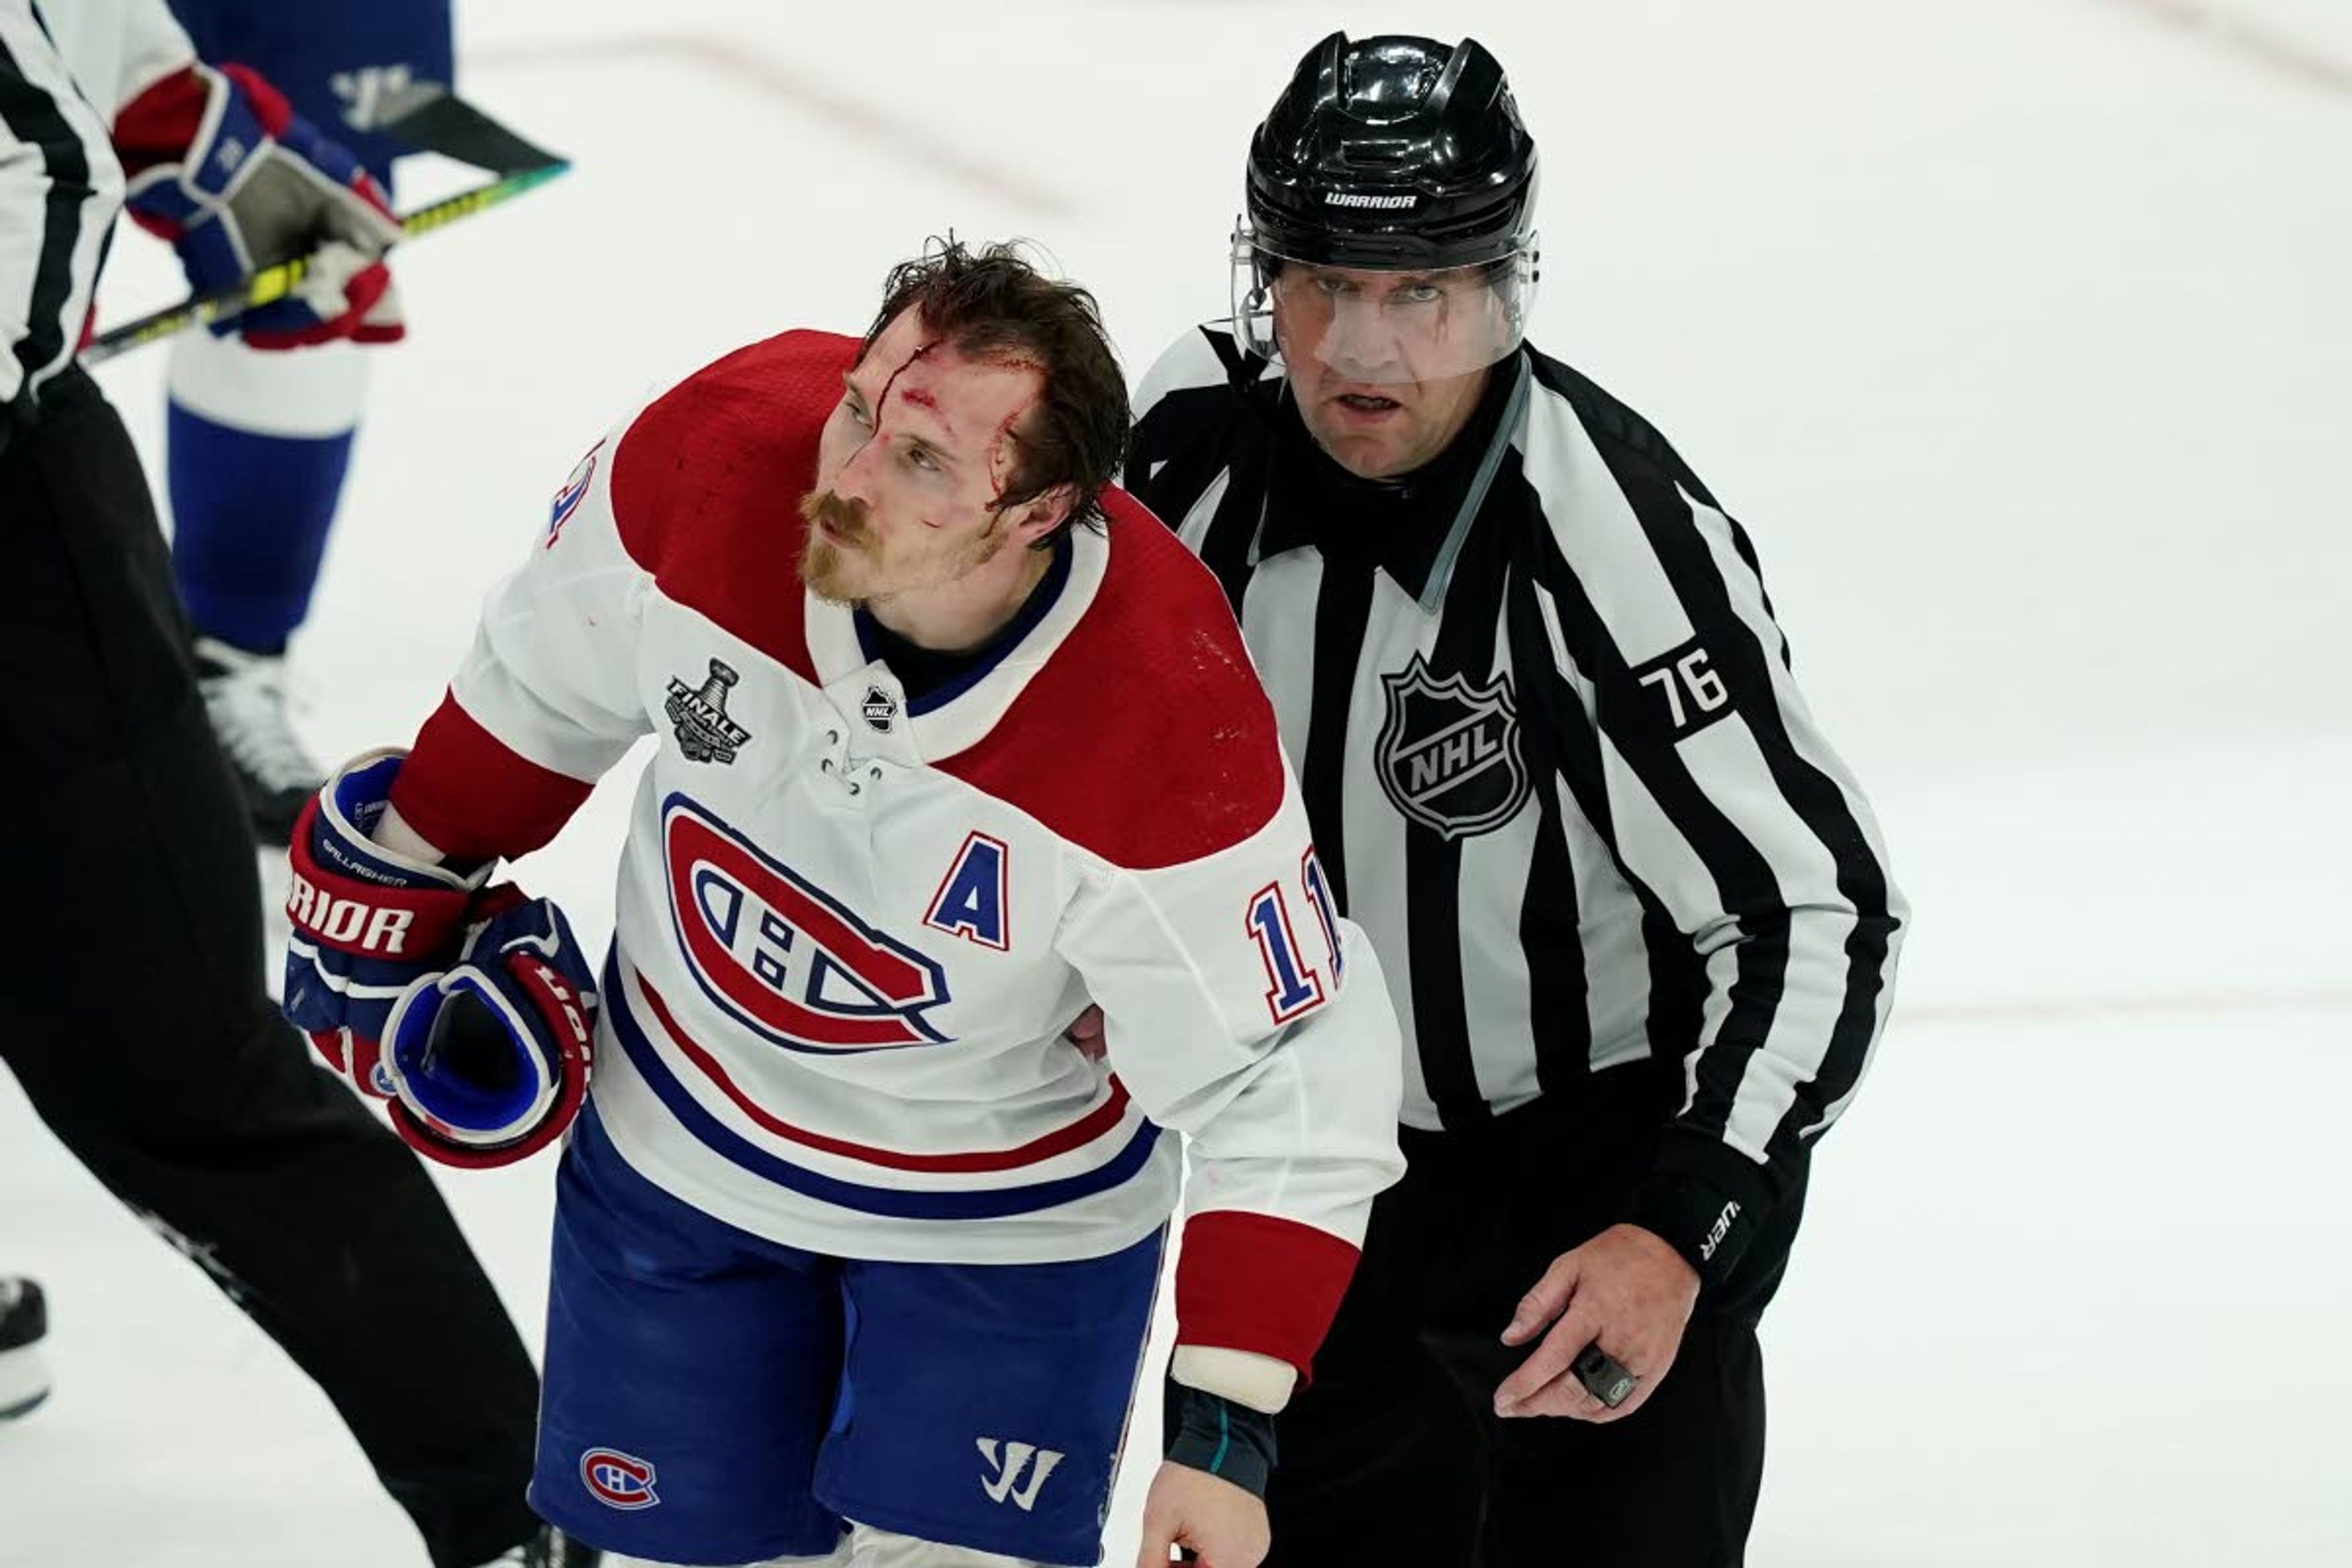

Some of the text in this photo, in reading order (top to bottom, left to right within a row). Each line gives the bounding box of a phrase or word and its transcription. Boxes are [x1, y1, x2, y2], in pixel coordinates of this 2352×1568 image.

[1325, 192, 1417, 209] WARRIOR
[670, 682, 746, 745] FINALE
[1638, 647, 1728, 728] 76
[1410, 723, 1498, 793] NHL
[922, 829, 1011, 952] A
[1245, 843, 1343, 1026] 11
